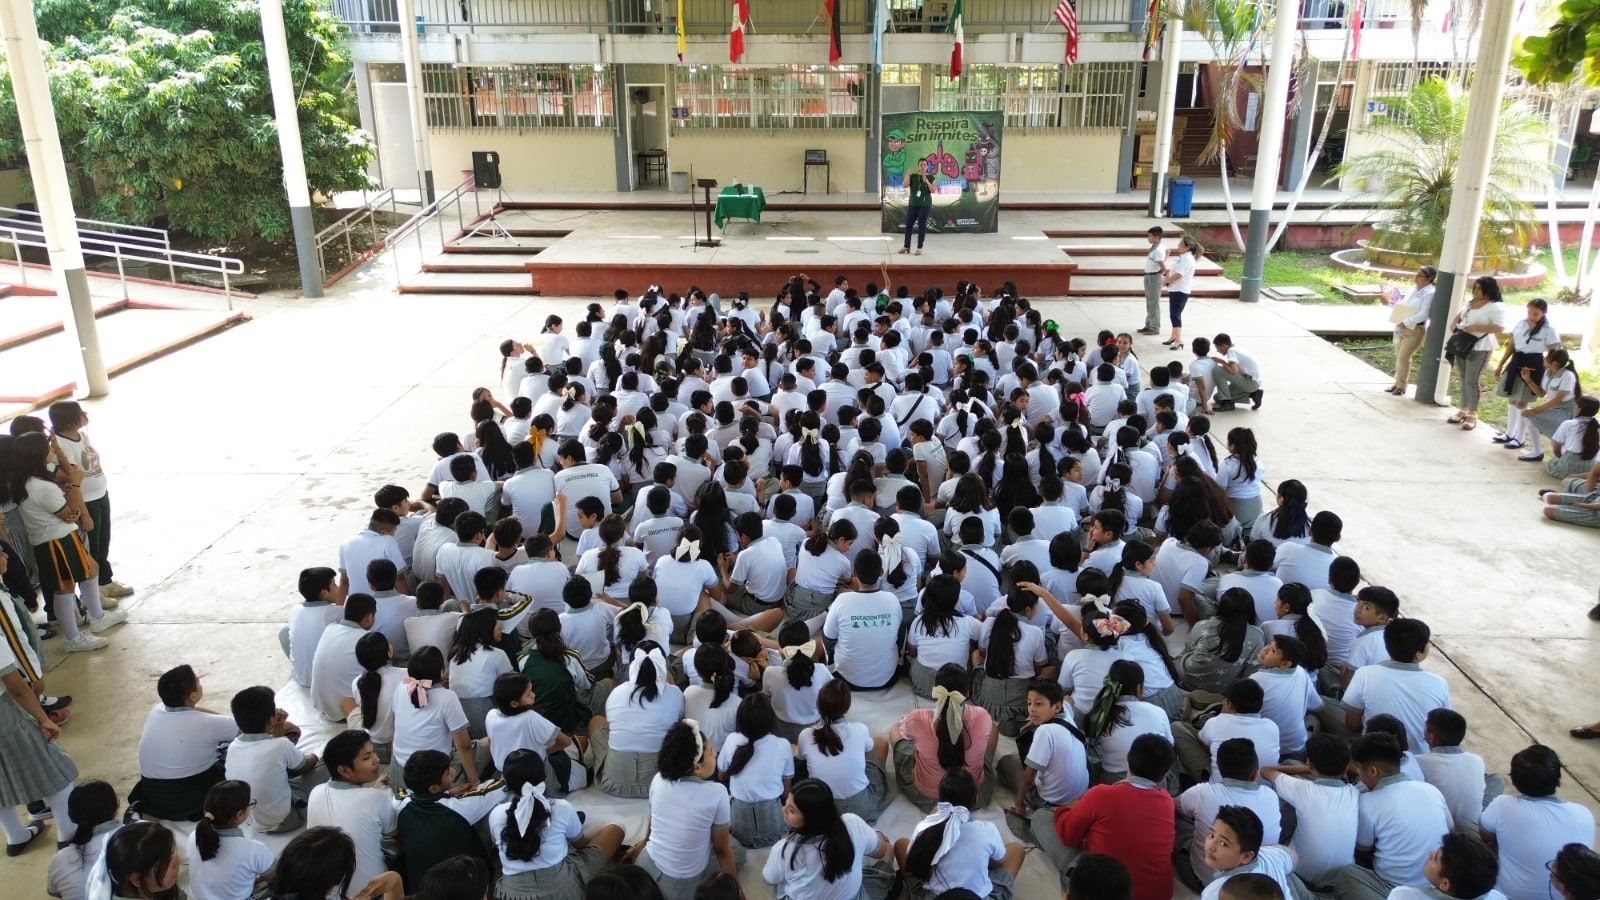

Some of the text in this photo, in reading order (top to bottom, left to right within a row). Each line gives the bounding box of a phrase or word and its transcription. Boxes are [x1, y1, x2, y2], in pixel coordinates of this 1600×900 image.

[671, 107, 689, 118] 3 B
[1367, 101, 1375, 112] 3
[916, 117, 969, 132] Respira
[906, 130, 927, 143] sin
